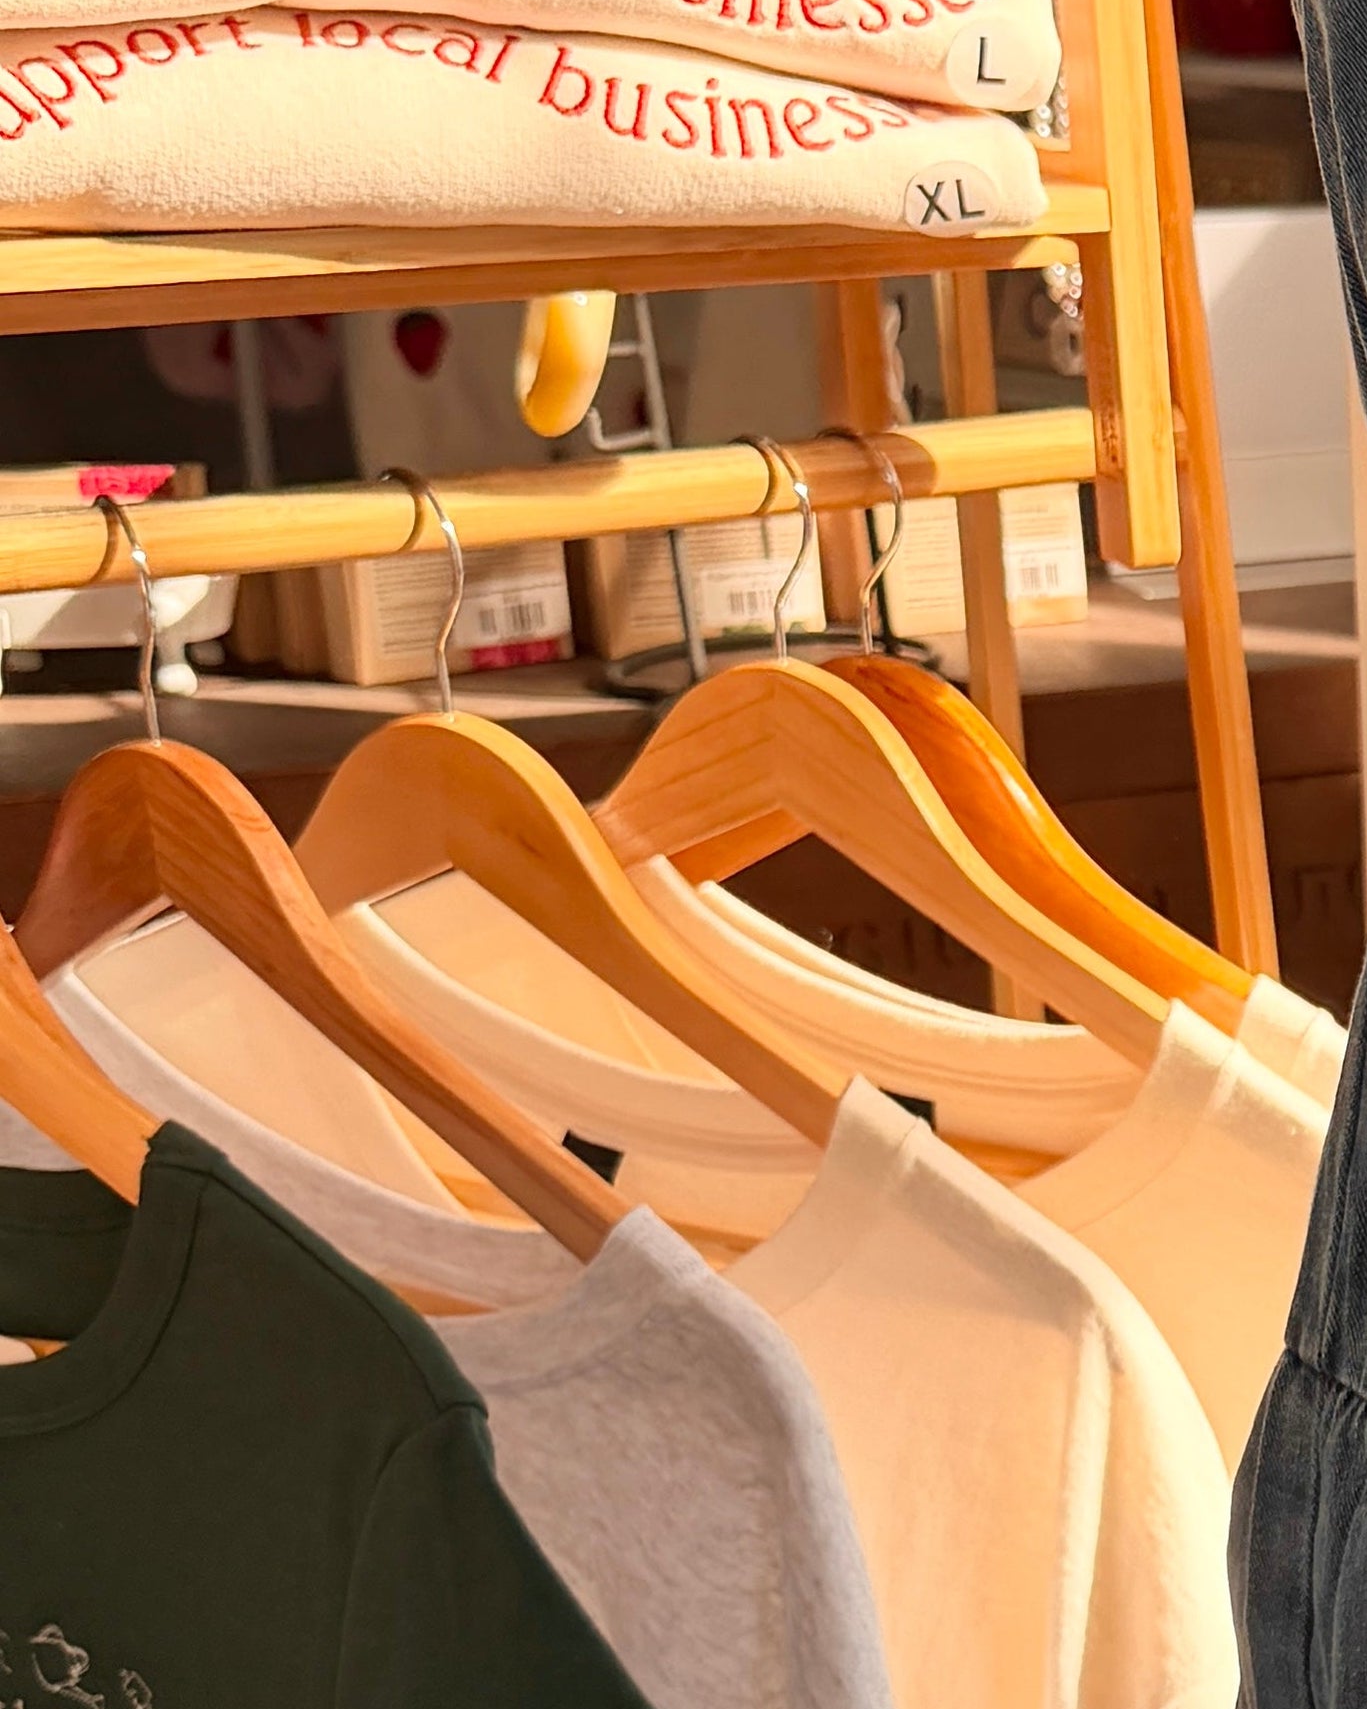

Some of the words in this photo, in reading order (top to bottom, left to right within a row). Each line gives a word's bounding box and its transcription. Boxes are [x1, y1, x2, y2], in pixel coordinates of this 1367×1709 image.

[976, 36, 1007, 86] L
[0, 13, 264, 140] upport
[294, 12, 522, 84] local
[538, 45, 909, 161] business
[915, 179, 987, 225] XL
